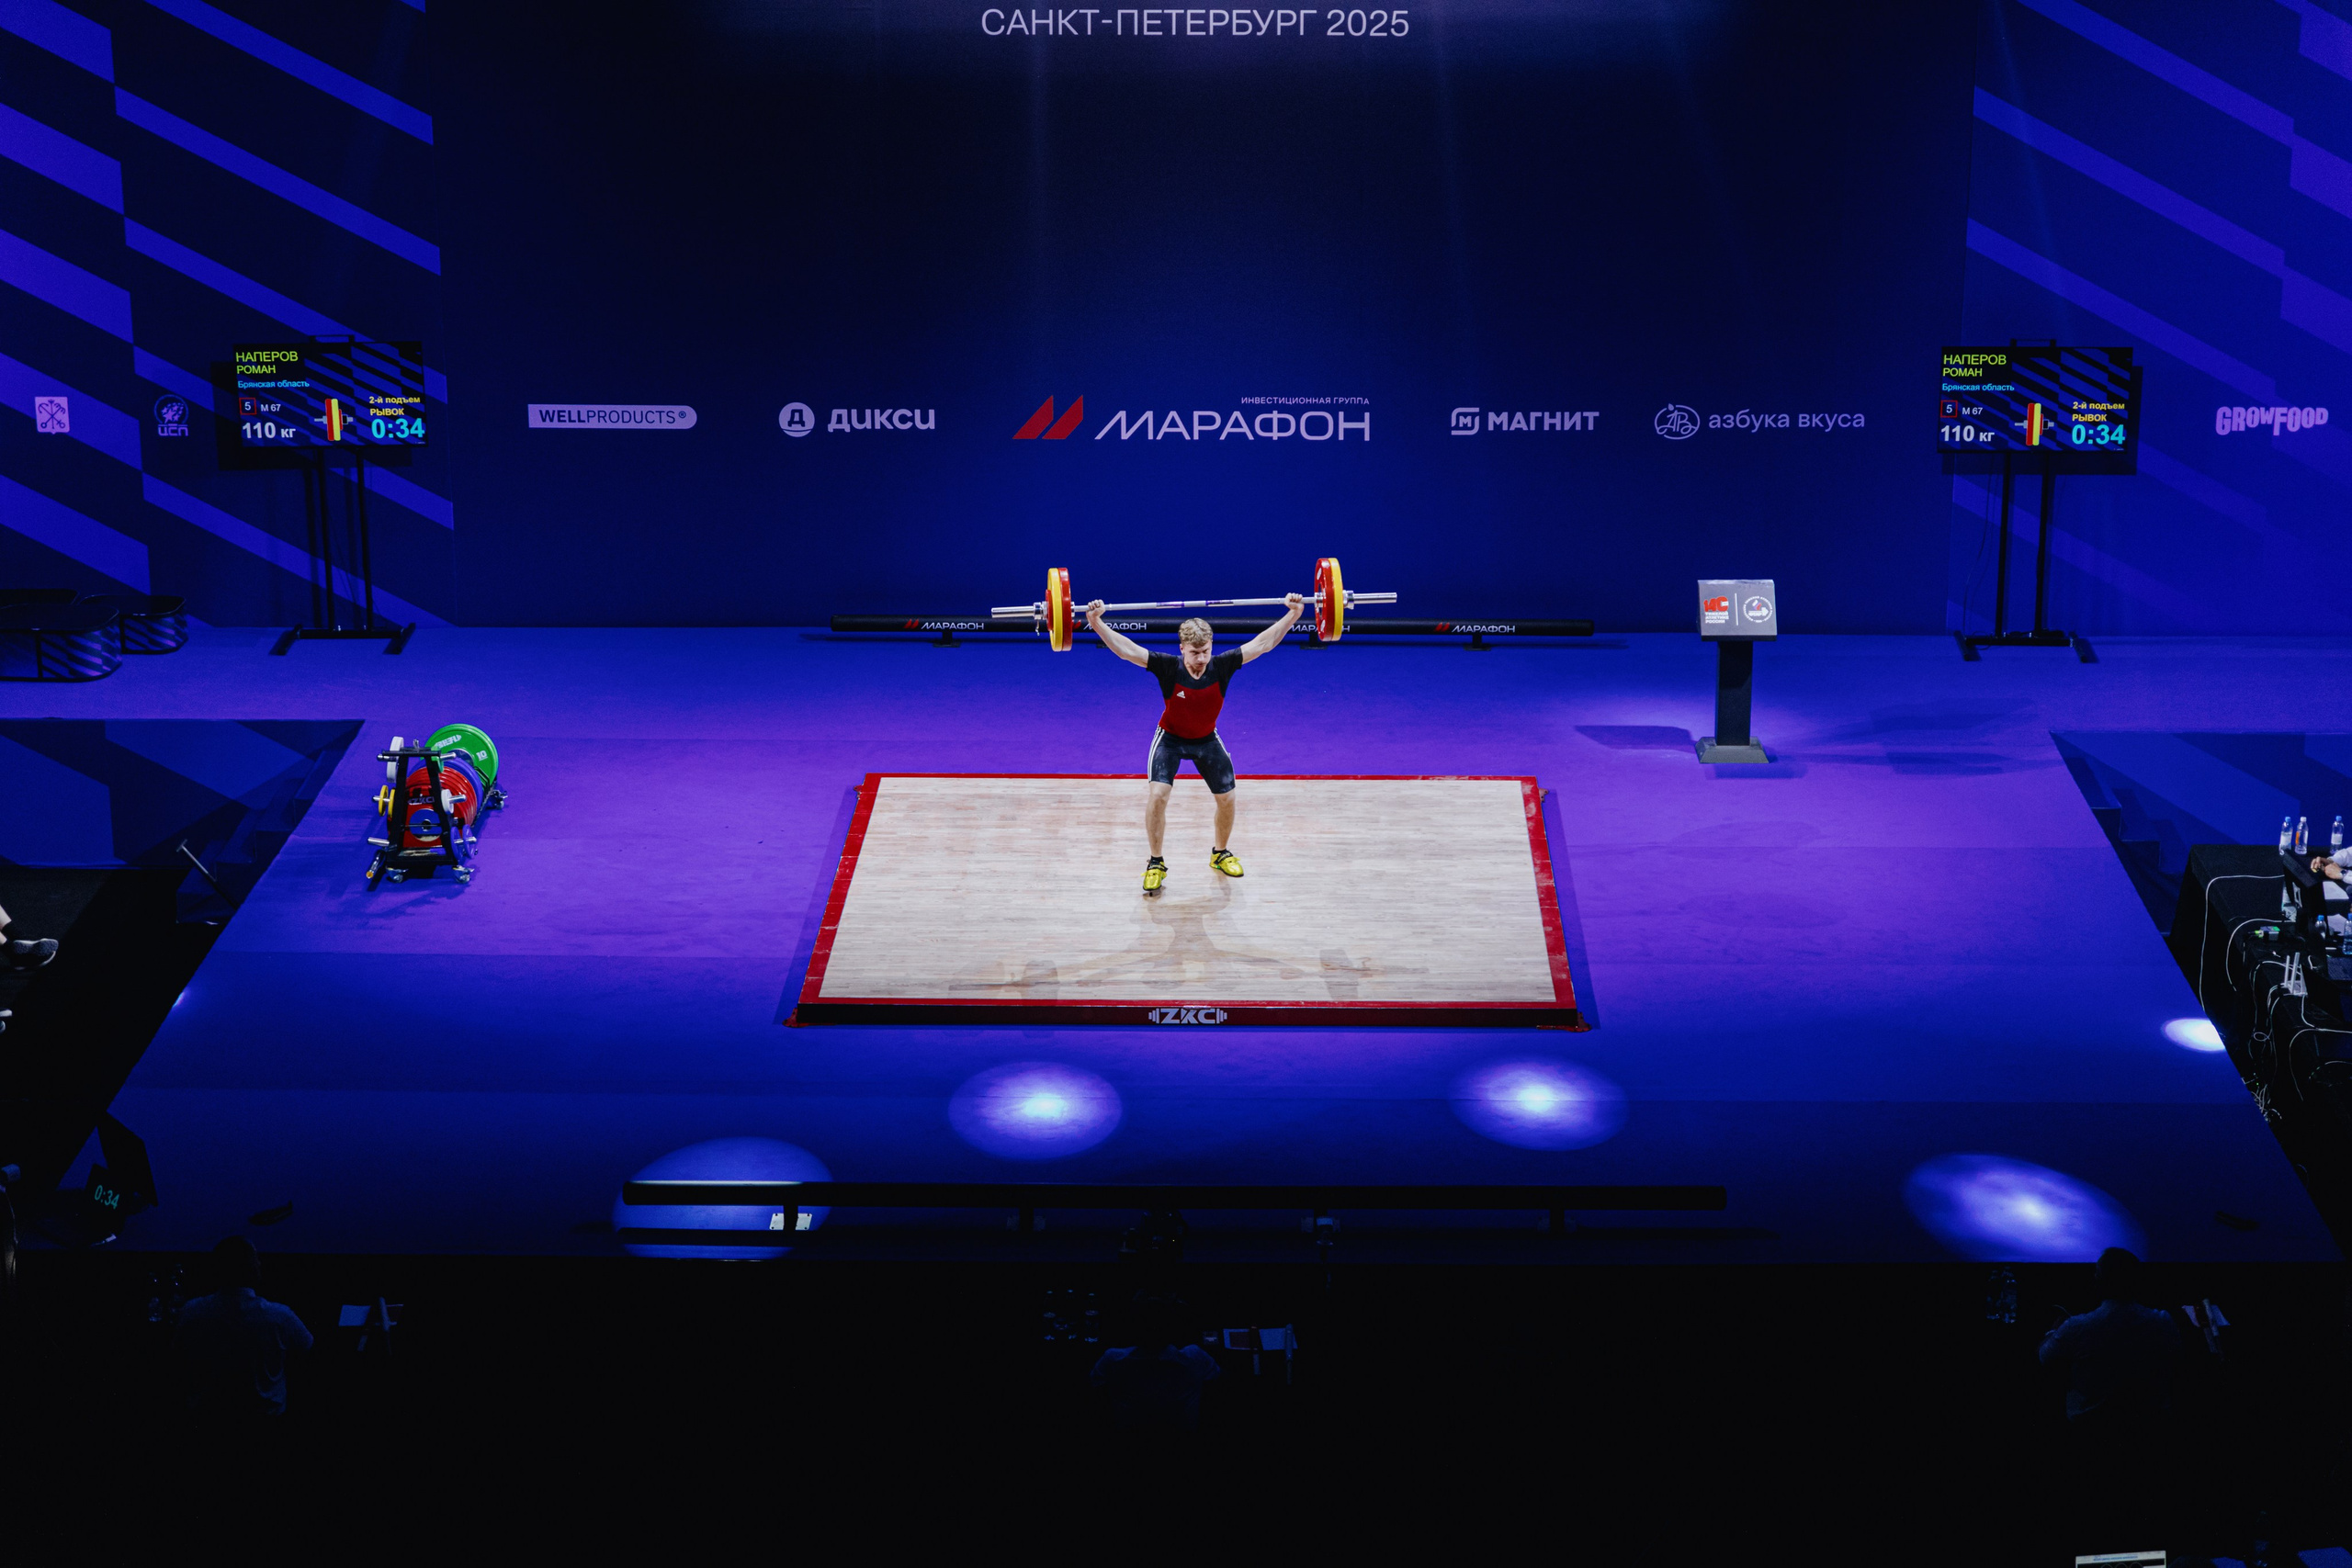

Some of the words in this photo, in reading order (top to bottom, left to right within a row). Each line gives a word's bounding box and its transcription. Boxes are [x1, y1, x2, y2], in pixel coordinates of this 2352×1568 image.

[980, 8, 1317, 37] САНКТ-ПЕТЕРБУРГ
[1326, 9, 1409, 37] 2025
[236, 351, 299, 362] НАПЕРОВ
[1943, 354, 2007, 365] НАПЕРОВ
[236, 365, 276, 374] РОМАН
[1942, 367, 1983, 377] РОМАН
[237, 380, 276, 389] Брянская
[277, 379, 310, 389] область
[1941, 384, 1980, 392] Брянская
[1982, 383, 2015, 391] область
[368, 396, 383, 404] 2-й
[385, 397, 421, 405] подъем
[1240, 396, 1331, 405] ИНВЕСТИЦИОННАЯ
[1333, 397, 1370, 405] ГРУППА
[244, 401, 252, 411] 5
[270, 403, 281, 412] 67
[1946, 404, 1953, 413] 5
[1972, 407, 1984, 415] 67
[2072, 401, 2086, 410] 2-й
[2089, 402, 2125, 411] подъем
[369, 408, 404, 416] РЫВОК
[1487, 411, 1600, 432] МАГНИТ
[1708, 408, 1790, 433] азбука
[1798, 412, 1865, 433] вкуса
[2072, 413, 2107, 422] РЫВОК
[242, 423, 276, 438] 110
[280, 427, 296, 438] кг
[371, 418, 425, 438] 0:34
[1094, 410, 1371, 441] МАРАФОН
[1940, 424, 1974, 442] 110
[1979, 432, 1995, 442] кг
[2072, 423, 2126, 445] 0:34
[921, 622, 985, 631] МАРАФОН
[1083, 622, 1148, 630] МРАФОН
[1452, 625, 1516, 633] МАРАФОН
[1160, 1008, 1216, 1024] ZKC
[94, 1184, 120, 1210] 0:34
